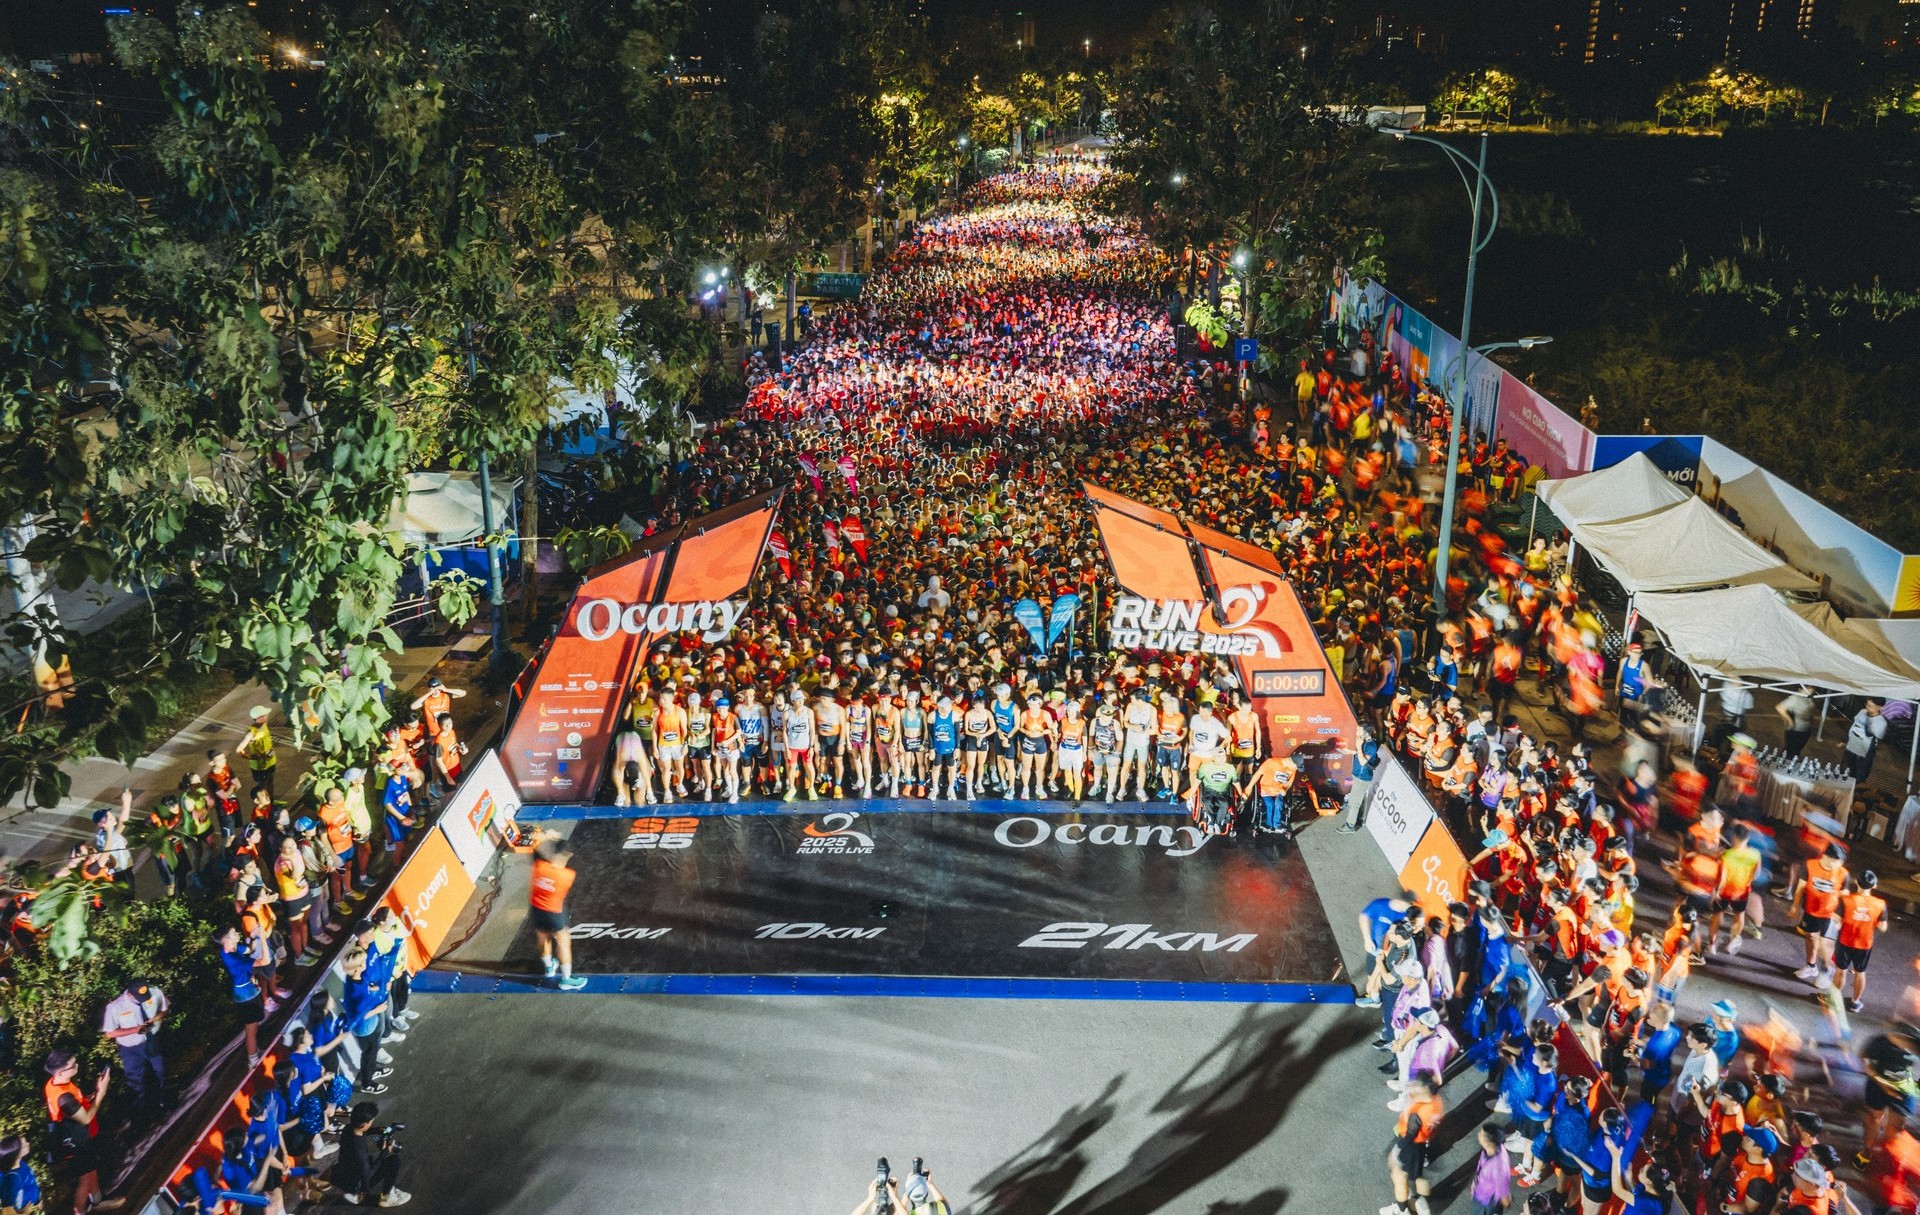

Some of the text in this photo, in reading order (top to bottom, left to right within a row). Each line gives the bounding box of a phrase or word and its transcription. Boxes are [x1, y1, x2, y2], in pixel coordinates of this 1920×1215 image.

[817, 277, 861, 286] CREATIVE
[1241, 344, 1251, 356] P
[1667, 467, 1695, 482] MỚI
[576, 597, 749, 643] Ocany
[1112, 597, 1203, 631] RUN
[1111, 628, 1259, 657] TO LIVE 2025
[1255, 676, 1319, 691] 0:00:00
[1373, 782, 1407, 834] cocoon
[630, 817, 700, 834] S2
[622, 833, 694, 850] 25
[800, 837, 849, 847] 2025
[994, 817, 1214, 857] Ocany
[418, 864, 448, 911] Ocany
[570, 923, 673, 940] 5KM
[754, 922, 888, 940] 10KM
[1017, 921, 1259, 952] 21KM
